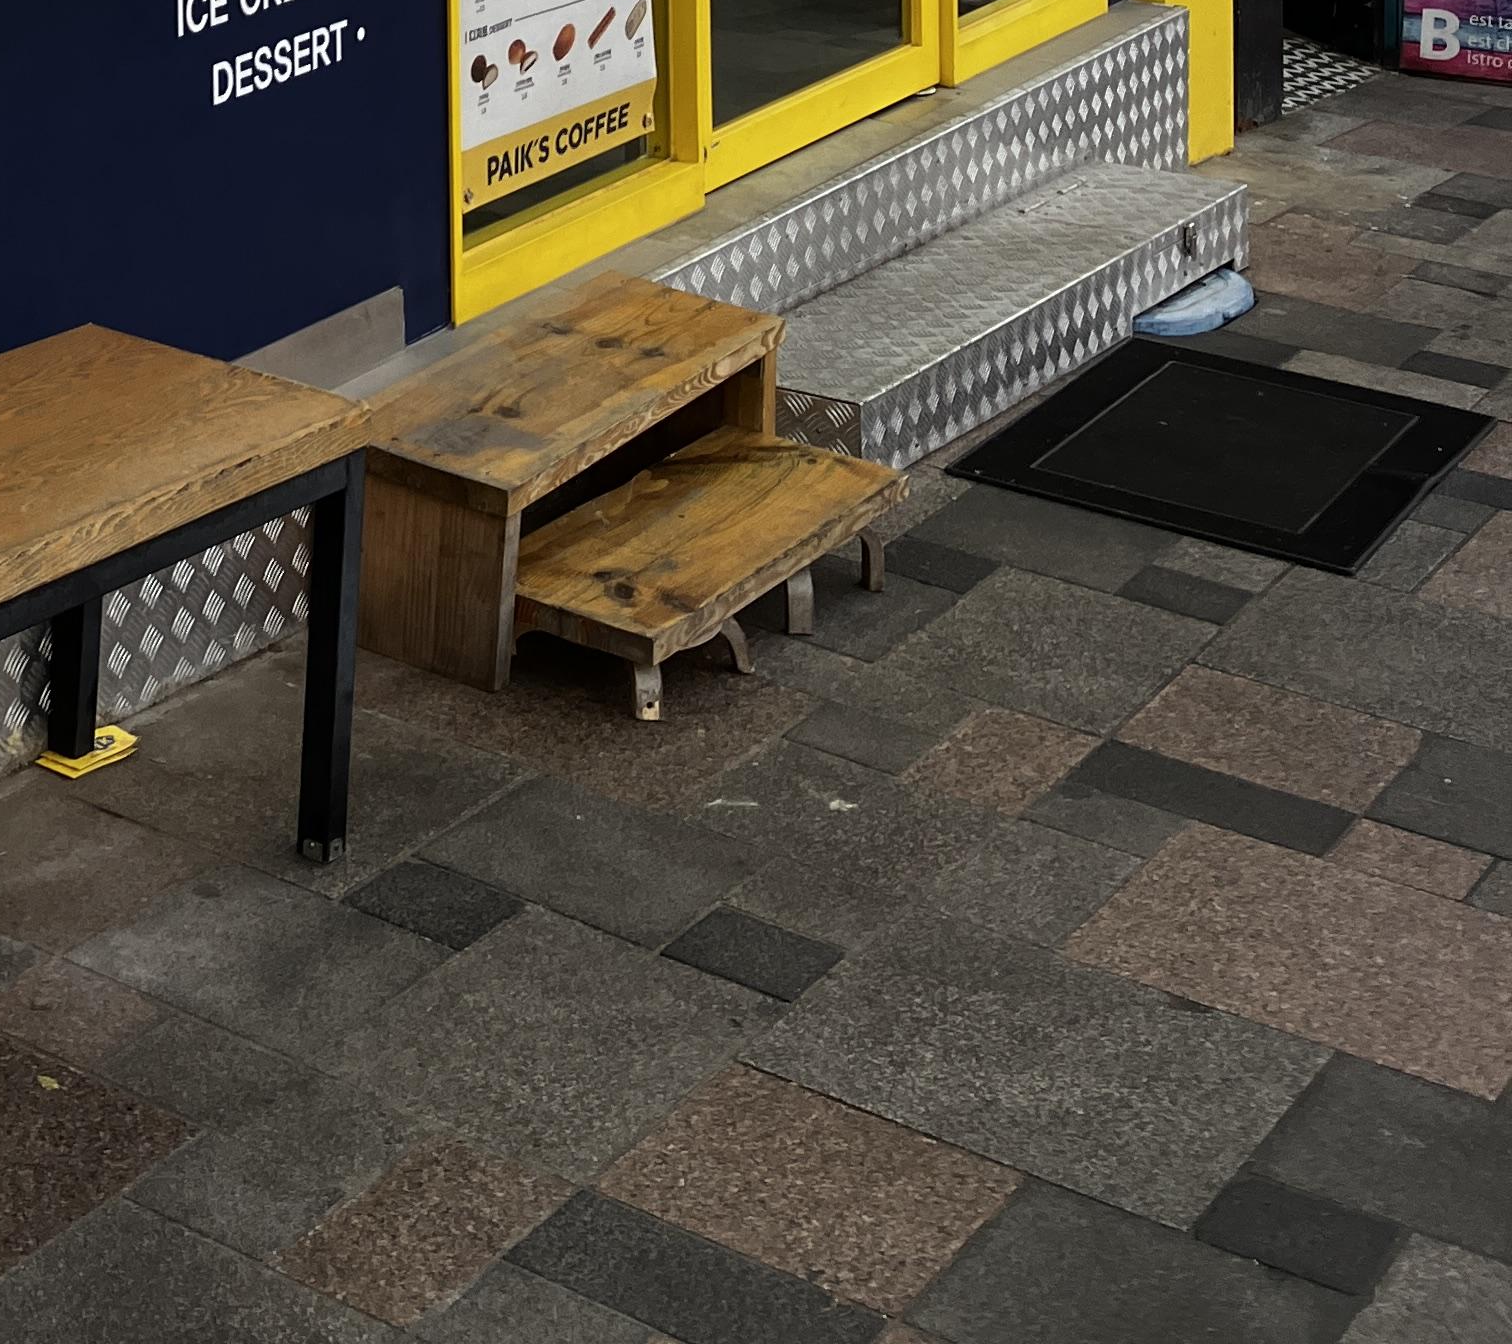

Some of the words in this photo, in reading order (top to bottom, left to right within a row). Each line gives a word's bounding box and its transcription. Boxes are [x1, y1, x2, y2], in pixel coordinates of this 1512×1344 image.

[212, 18, 348, 106] DESSERT
[1469, 13, 1494, 28] est
[487, 135, 550, 186] PAIK'S
[555, 102, 630, 155] COFFEE
